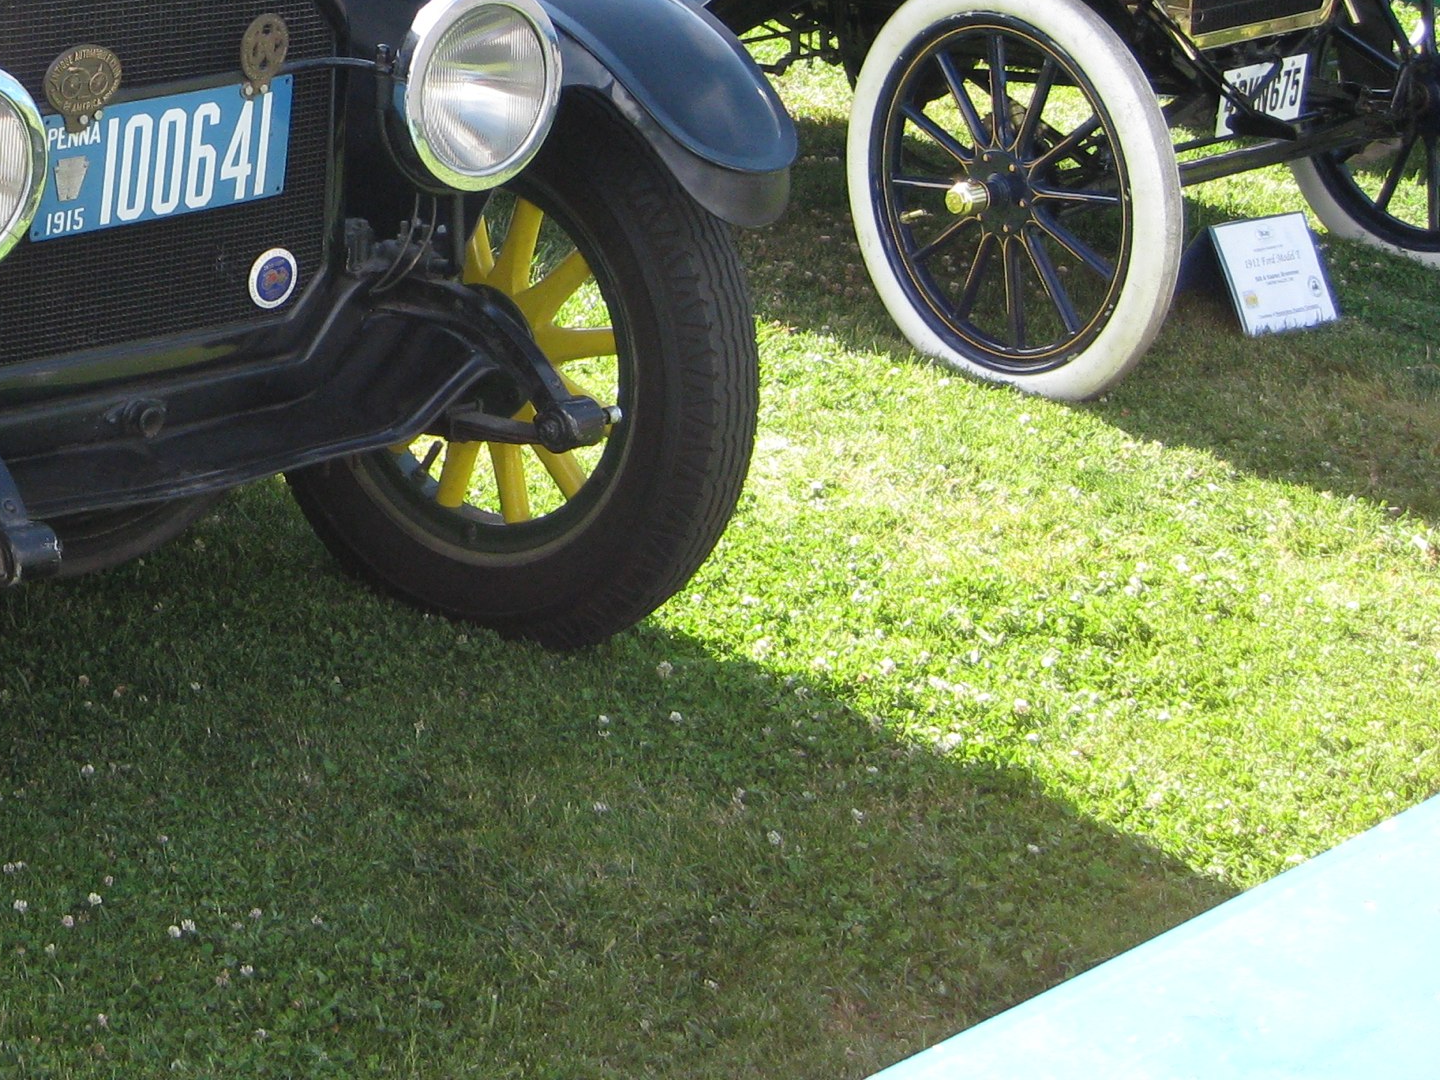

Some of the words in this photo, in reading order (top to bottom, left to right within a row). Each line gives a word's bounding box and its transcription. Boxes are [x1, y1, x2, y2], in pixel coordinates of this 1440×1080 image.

[47, 122, 101, 152] PENNA
[100, 91, 274, 226] 100641
[45, 207, 85, 237] 1915
